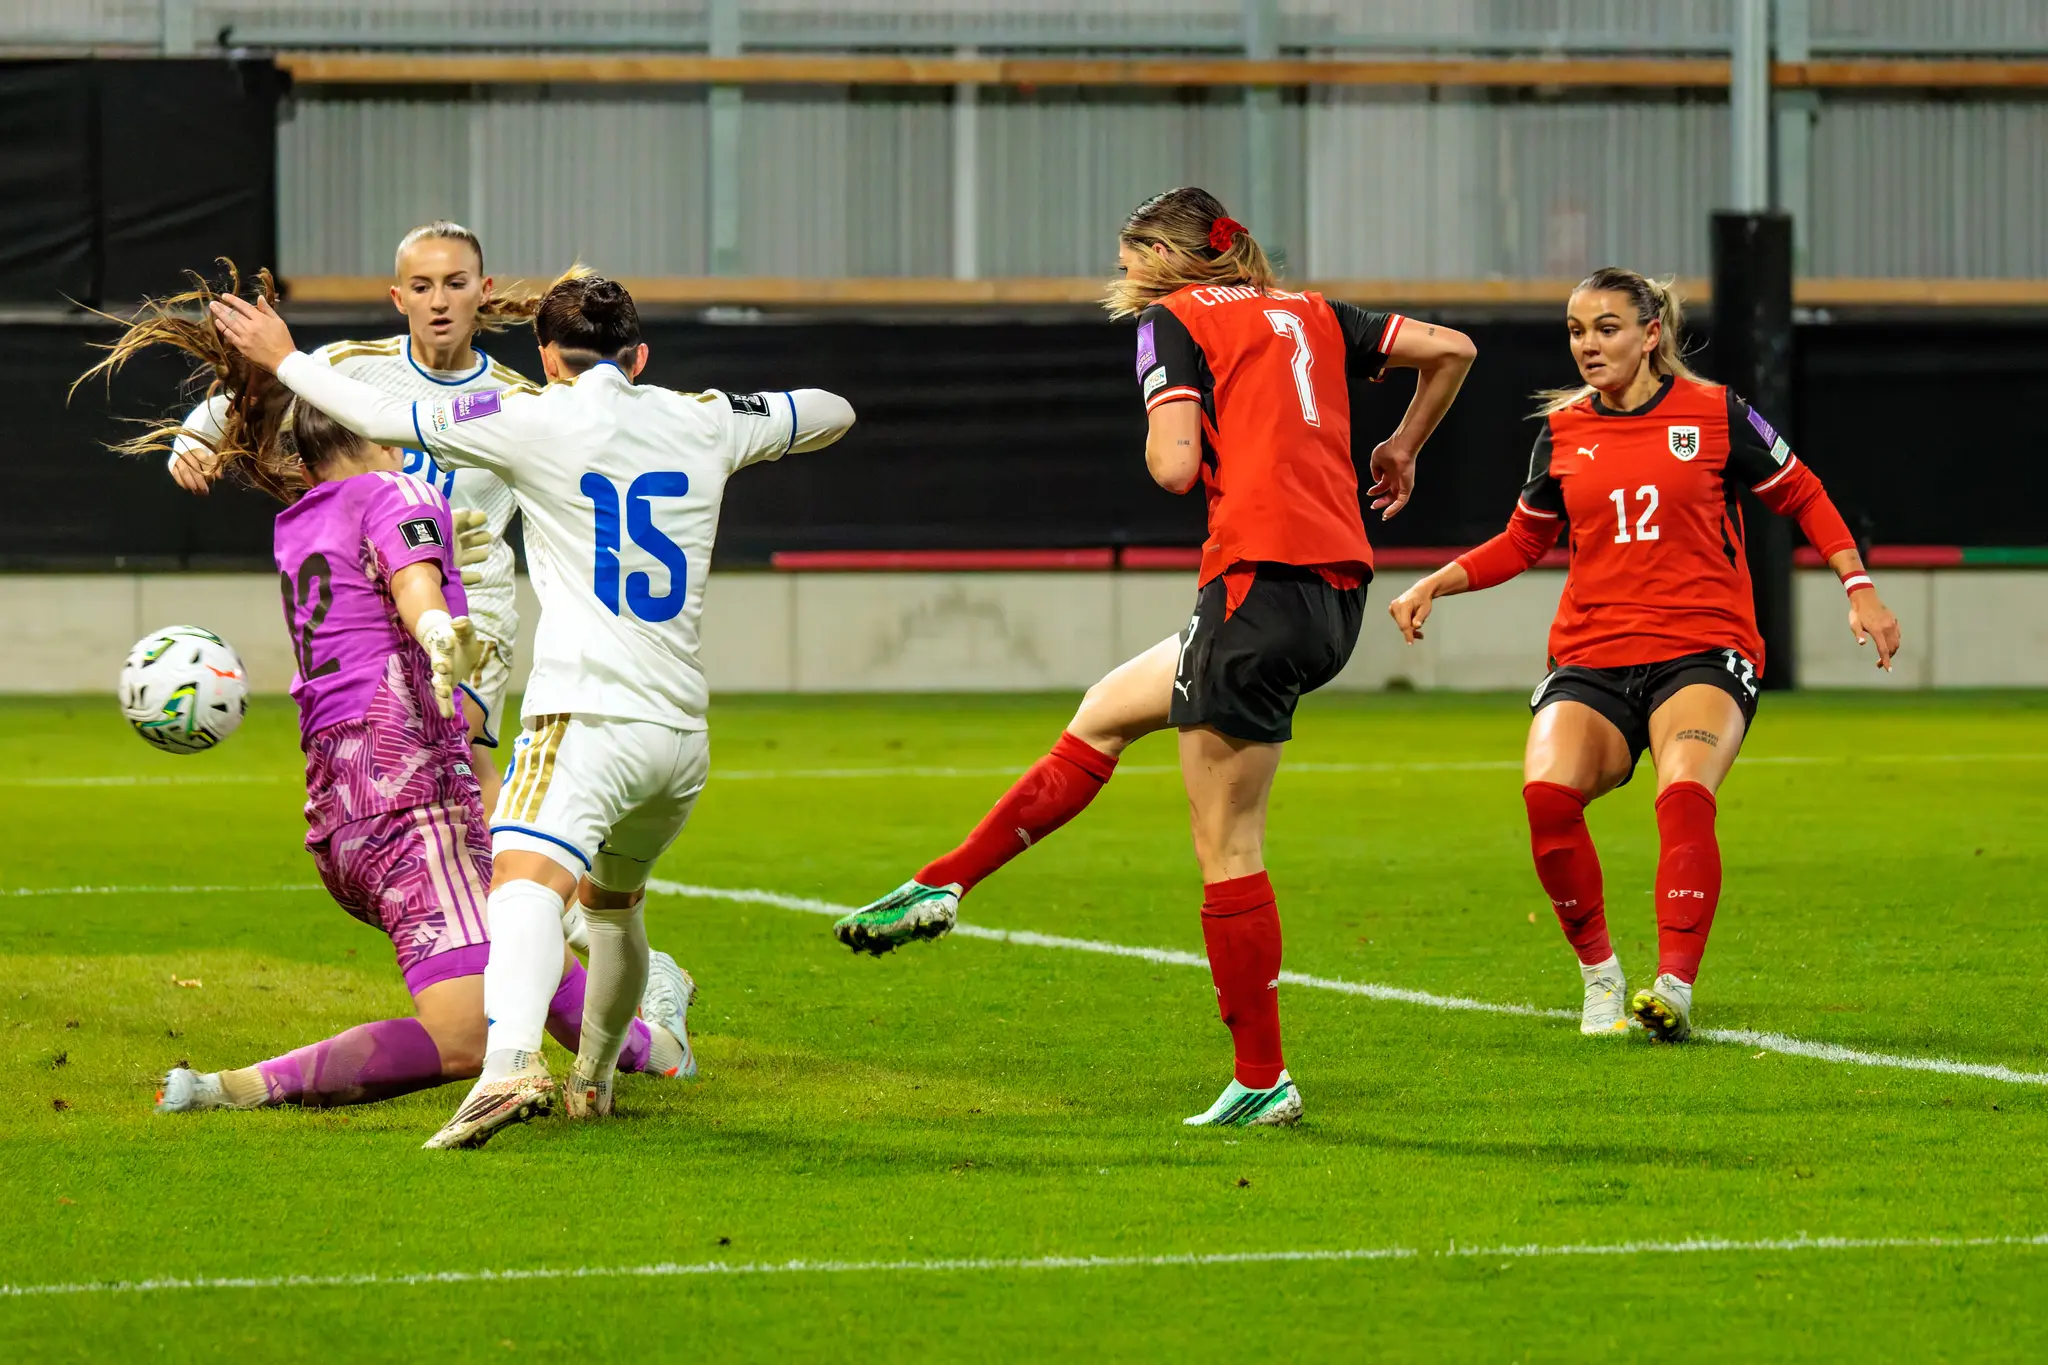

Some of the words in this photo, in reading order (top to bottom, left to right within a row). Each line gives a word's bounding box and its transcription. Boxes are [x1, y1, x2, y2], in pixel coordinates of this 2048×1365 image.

[1263, 310, 1320, 427] 7
[580, 471, 689, 622] 15
[1609, 484, 1659, 544] 12
[1178, 616, 1200, 677] 7
